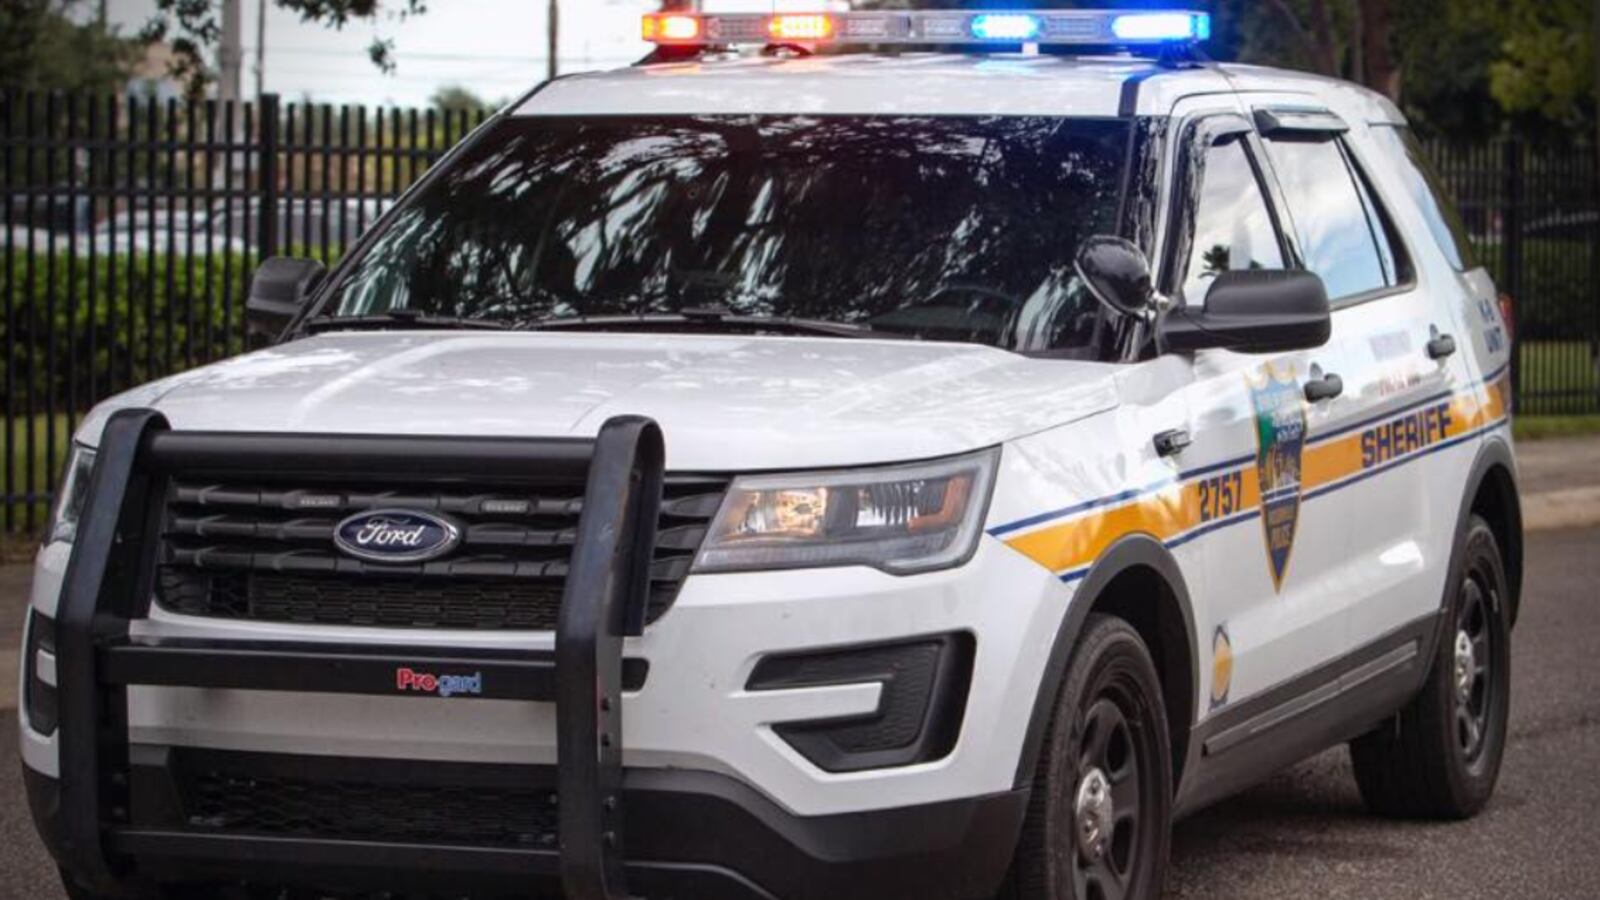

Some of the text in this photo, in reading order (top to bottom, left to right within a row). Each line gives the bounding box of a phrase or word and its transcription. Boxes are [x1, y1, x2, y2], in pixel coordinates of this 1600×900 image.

[1361, 402, 1451, 468] SHERIFF
[1198, 470, 1242, 522] 2757
[357, 517, 425, 545] Ford
